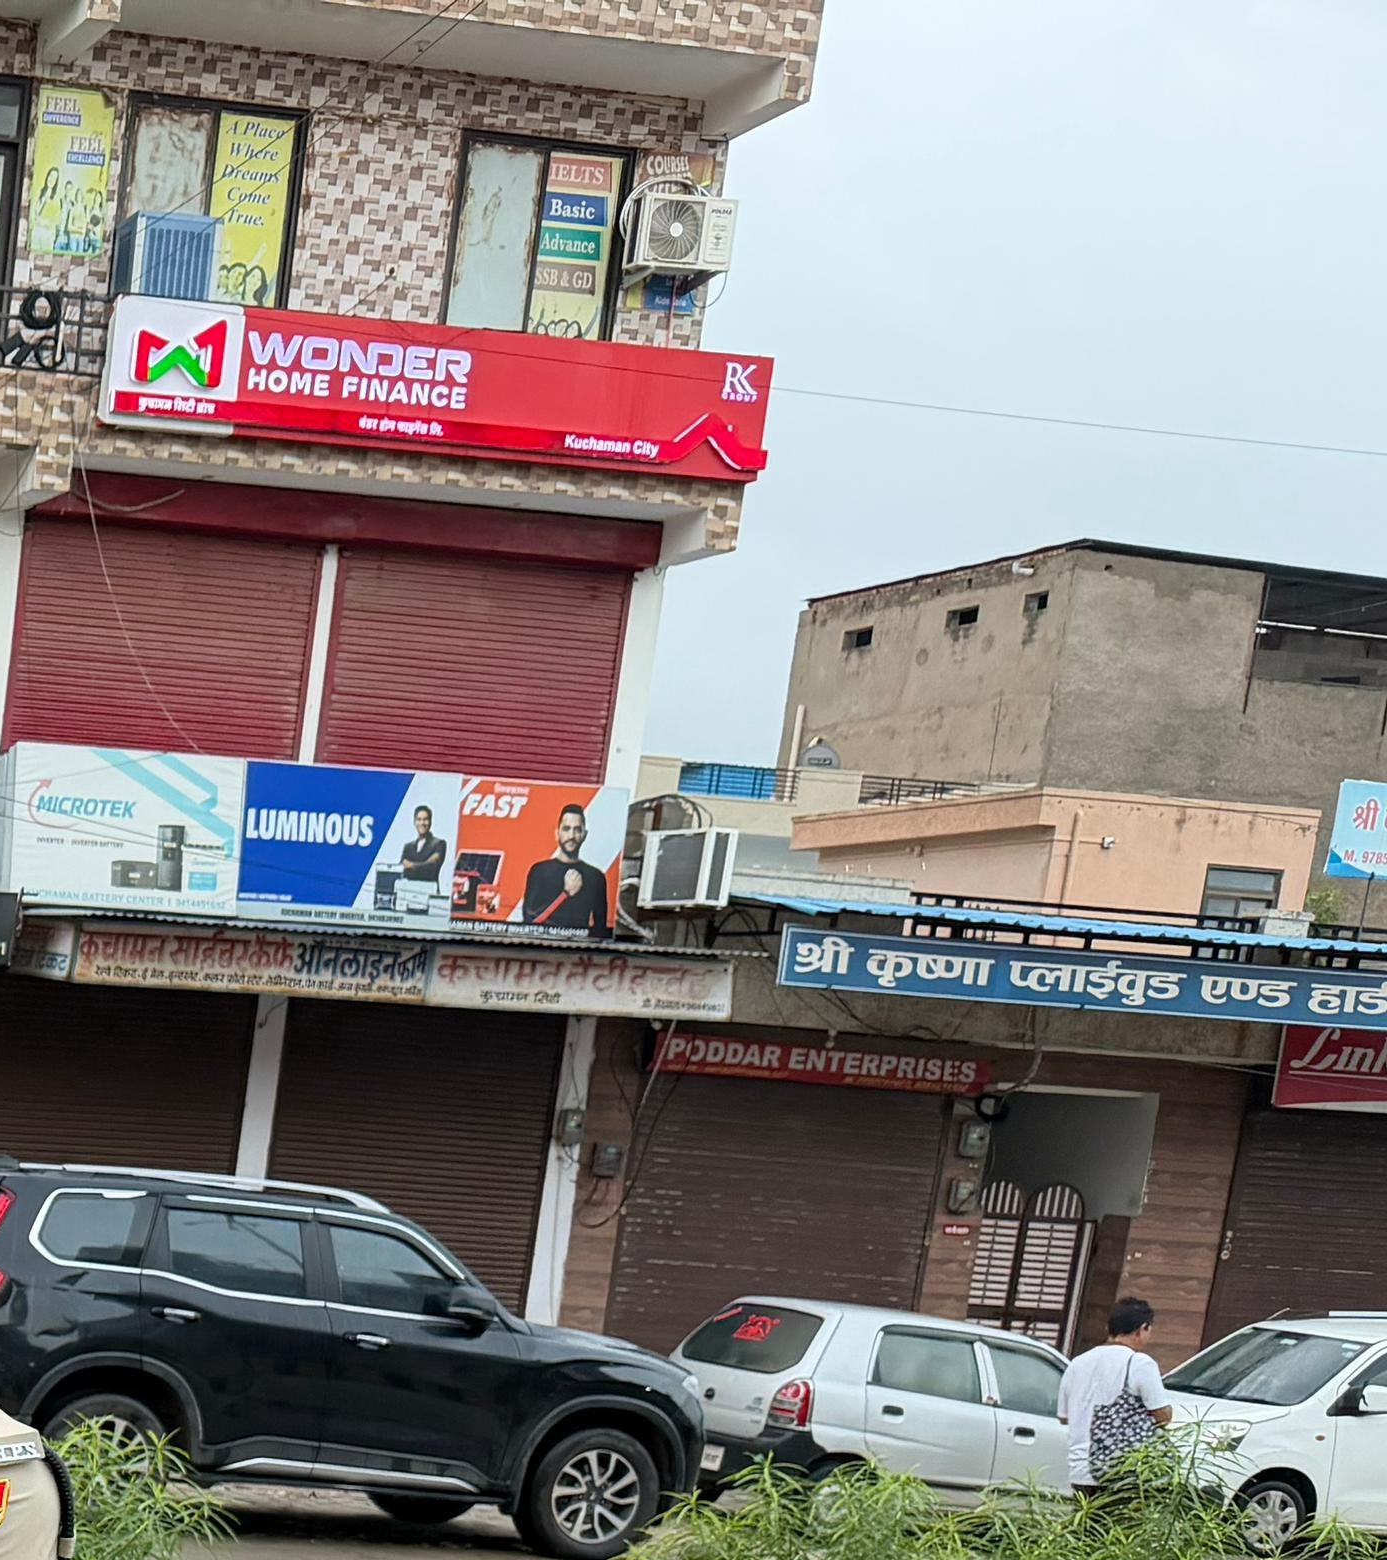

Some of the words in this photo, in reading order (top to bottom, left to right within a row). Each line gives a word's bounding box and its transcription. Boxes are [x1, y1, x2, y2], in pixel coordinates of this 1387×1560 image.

[44, 95, 81, 113] FEEL
[42, 112, 82, 126] DIFFERENCE
[225, 120, 238, 135] A
[242, 121, 286, 140] Place
[69, 135, 106, 153] FEEL
[229, 141, 279, 162] Where
[66, 152, 106, 167] EXCELLENCE
[645, 155, 690, 175] COURSES
[223, 163, 281, 184] Dreams
[549, 162, 605, 184] IELTS
[226, 186, 272, 205] Come
[549, 199, 596, 220] Basic
[540, 232, 596, 255] Advance
[536, 266, 558, 286] SSB
[559, 268, 570, 287] &
[572, 269, 594, 289] GD
[247, 330, 472, 385] WONDER
[247, 367, 330, 397] HOME
[341, 376, 468, 410] FINANCE
[721, 391, 758, 403] GROUP
[563, 434, 629, 454] Kuchaman
[631, 440, 660, 459] City
[36, 794, 138, 820] MICROTEK
[462, 792, 529, 819] FAST
[1352, 798, 1380, 832] श्री
[245, 807, 374, 848] LUMINOUS
[1343, 849, 1358, 863] M.
[81, 892, 124, 903] BATTERY
[126, 895, 164, 906] CENTER
[794, 936, 856, 975] श्री
[865, 947, 995, 989] कृष्णा
[1008, 959, 1188, 1005] प्लाईवुड
[1199, 973, 1298, 1009] एण्ड
[666, 1036, 783, 1069] PODDAR
[787, 1047, 978, 1084] ENTERPRISES
